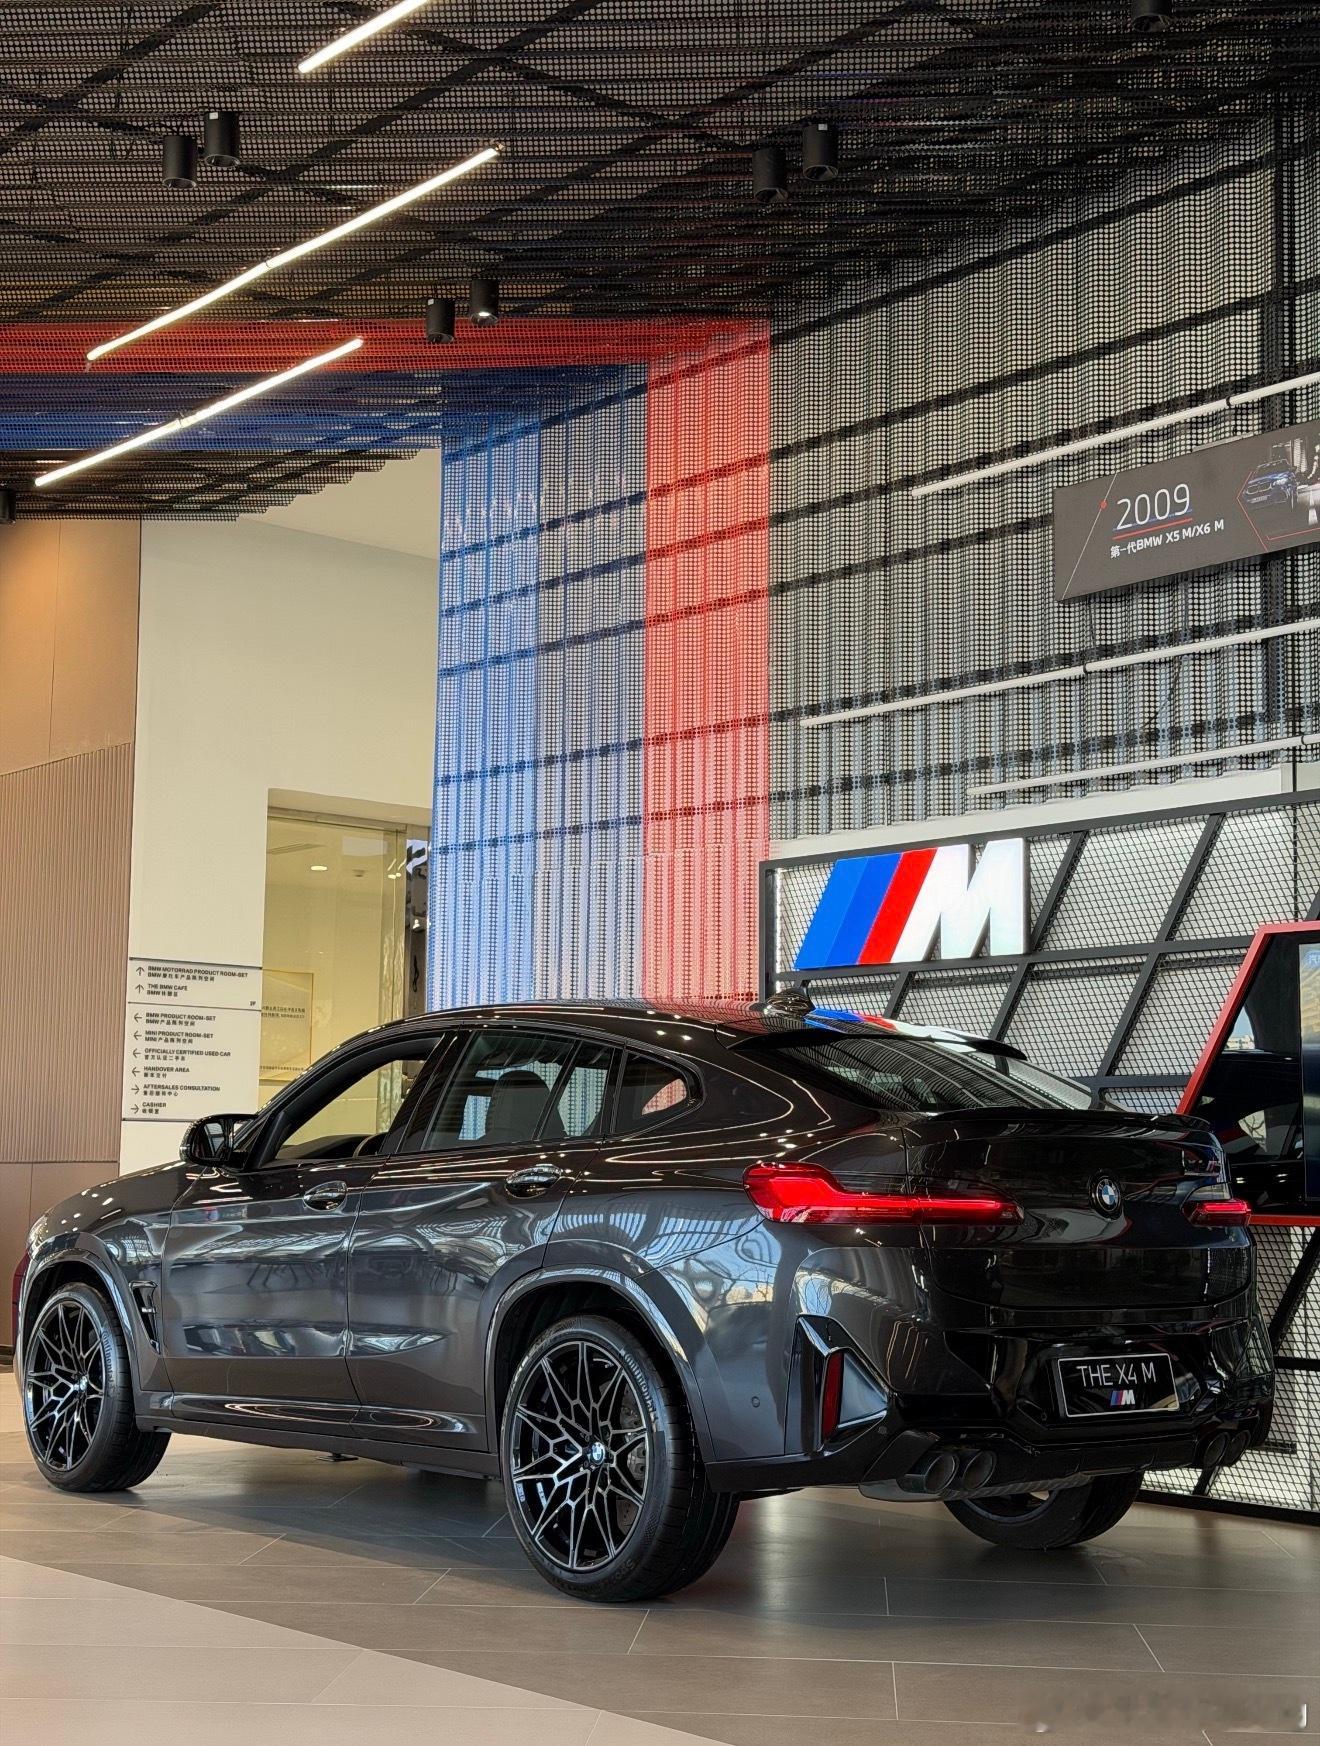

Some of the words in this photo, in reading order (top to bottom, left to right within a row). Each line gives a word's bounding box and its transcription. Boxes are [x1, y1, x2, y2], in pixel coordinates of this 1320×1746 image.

[1117, 483, 1190, 530] 2009
[1165, 530, 1180, 544] X5
[1214, 518, 1224, 531] M
[1076, 1364, 1114, 1387] THE
[1115, 1363, 1138, 1385] X4
[1141, 1361, 1157, 1383] M
